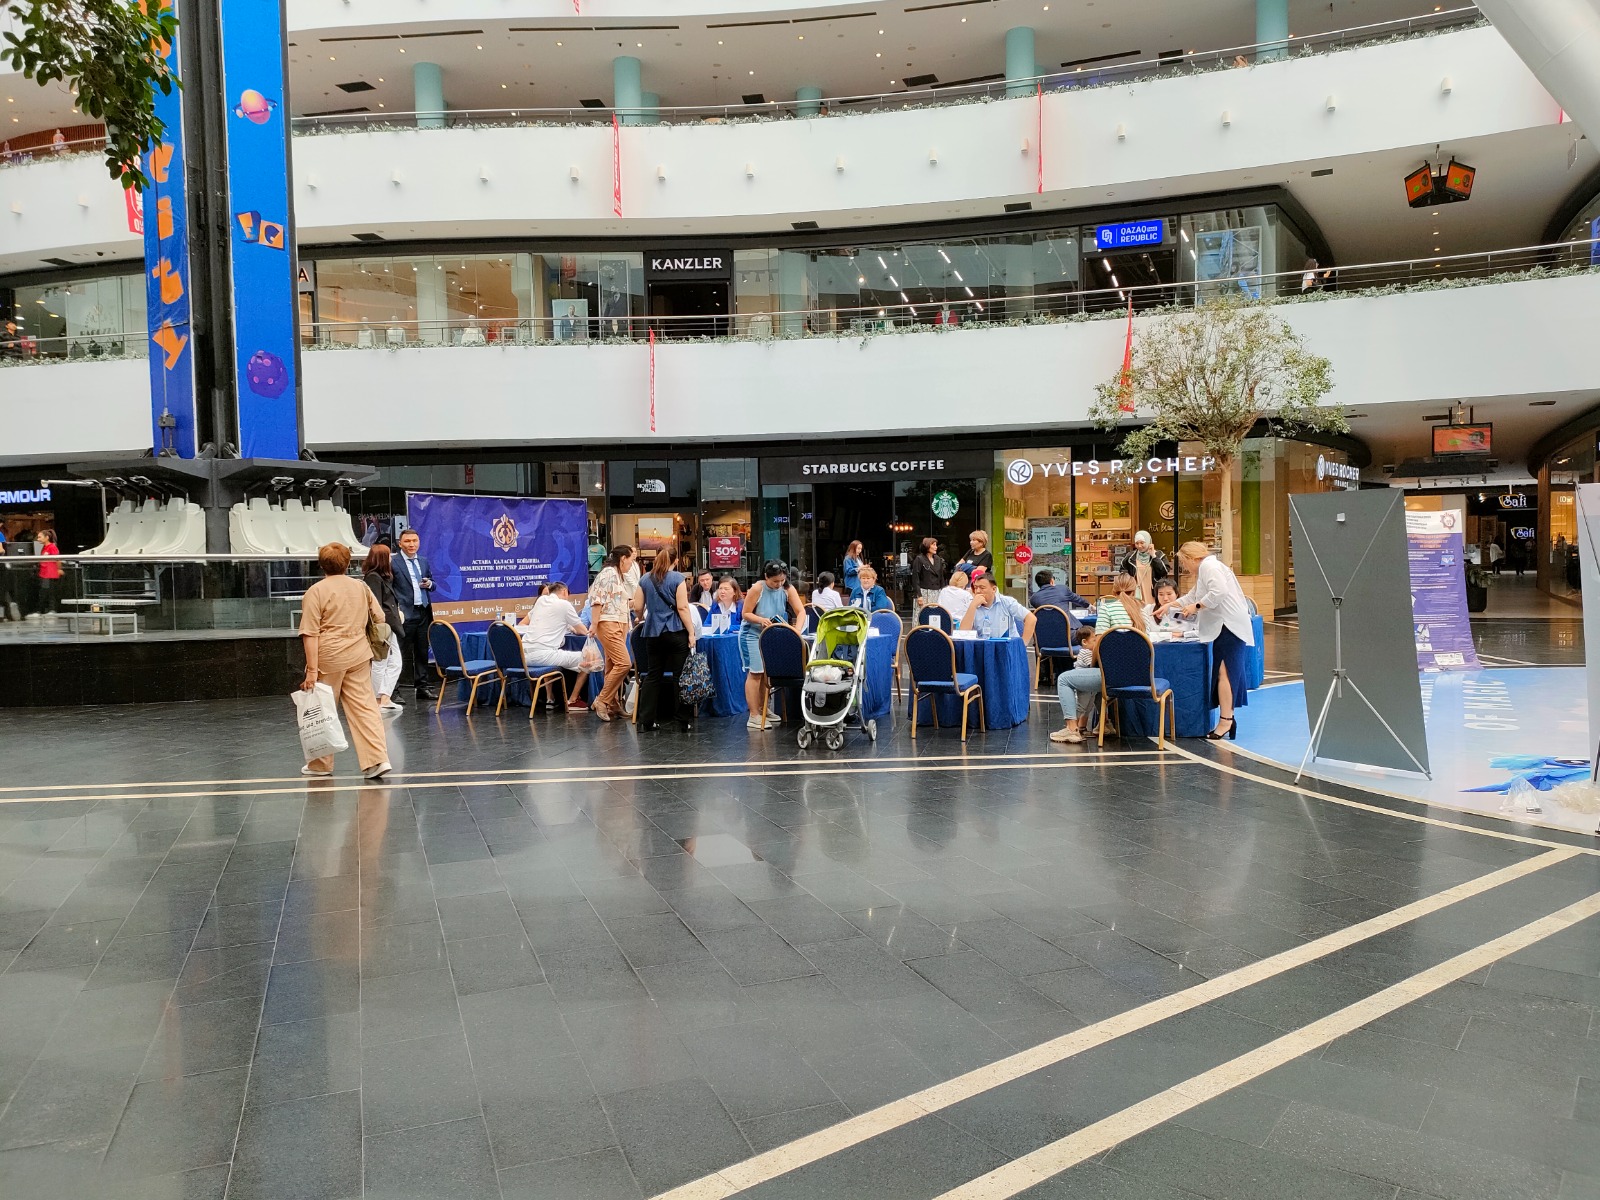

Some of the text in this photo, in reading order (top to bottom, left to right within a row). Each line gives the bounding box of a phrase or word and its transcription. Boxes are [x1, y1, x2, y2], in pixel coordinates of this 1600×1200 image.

[1121, 226, 1147, 235] QAZAQ
[1121, 233, 1157, 243] REPUBLIC
[652, 257, 723, 270] KANZLER
[802, 459, 945, 475] STARBUCKS COFFEE
[1040, 459, 1100, 478] YVES
[711, 547, 738, 556] -30%
[471, 605, 503, 614] kgd.gov.kz
